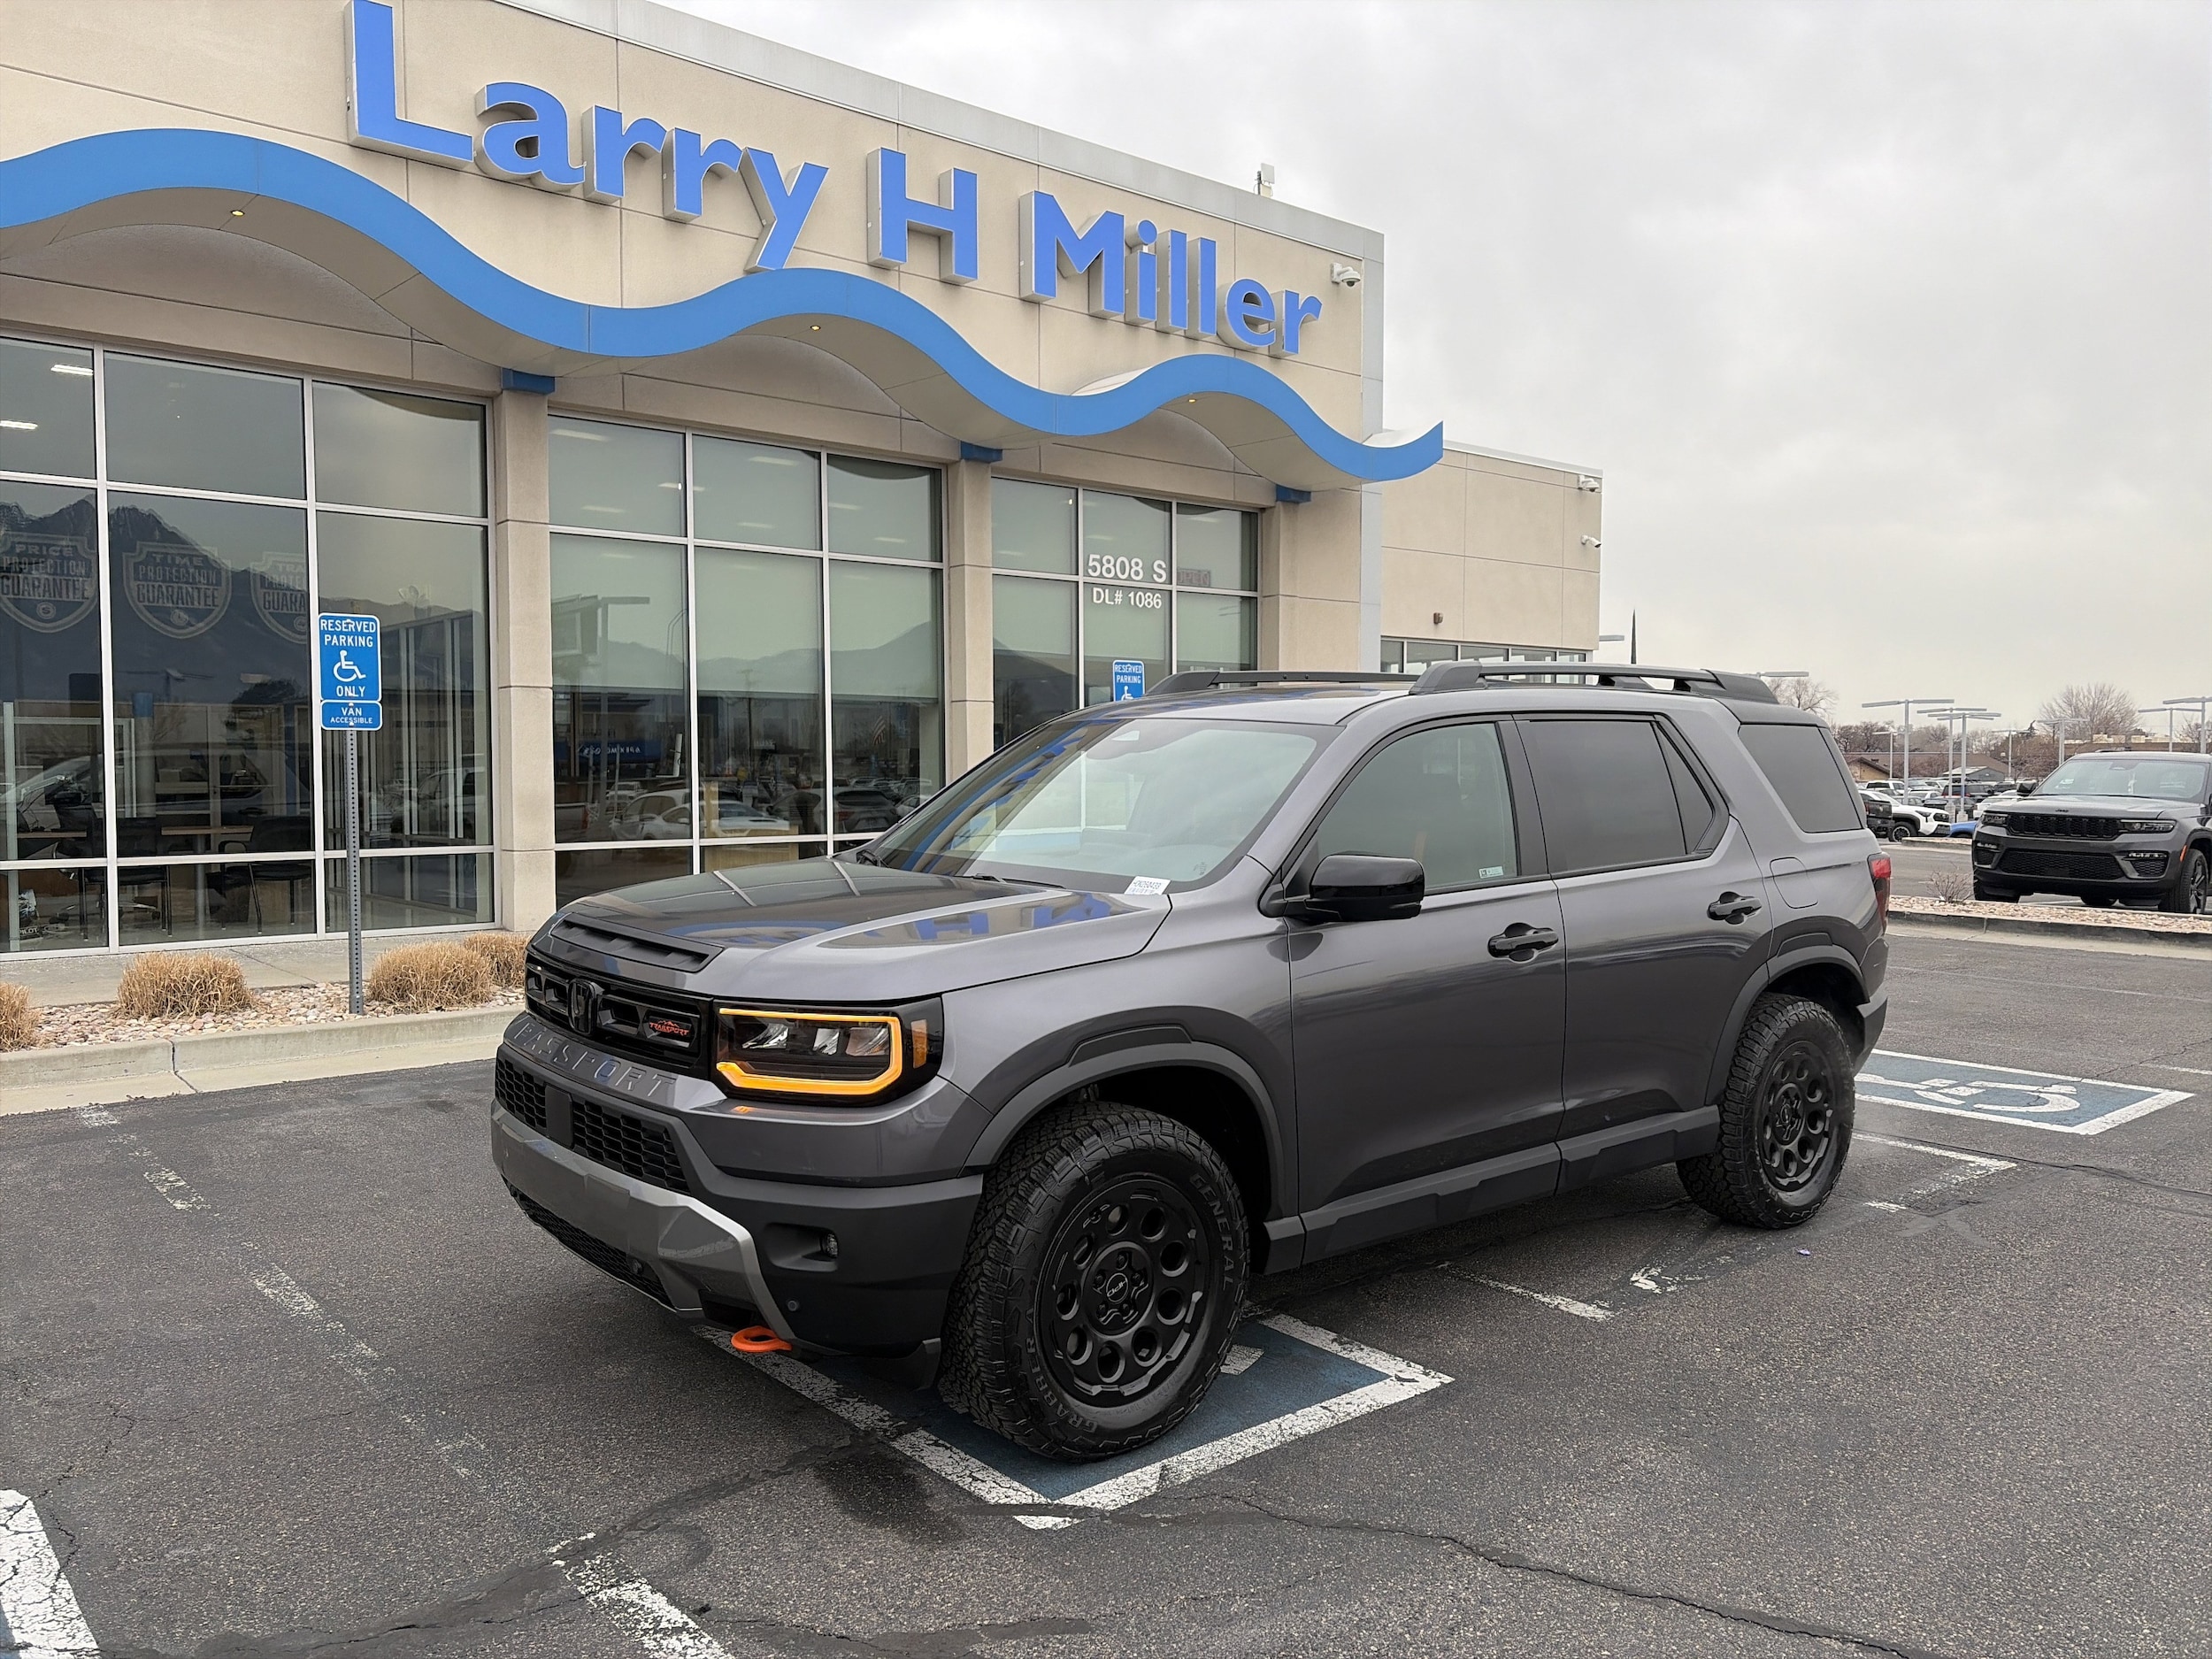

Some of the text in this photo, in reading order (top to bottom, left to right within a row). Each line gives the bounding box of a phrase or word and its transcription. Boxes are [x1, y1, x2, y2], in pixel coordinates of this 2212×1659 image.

[347, 0, 1323, 355] Larry H Miller
[15, 543, 73, 557] PRICE
[3, 556, 86, 576] PROTECTION
[151, 553, 204, 566] TIME
[139, 565, 217, 585] PROTECTION
[1087, 554, 1167, 583] 5808 S
[1, 574, 89, 601] GUARANTEE
[136, 584, 219, 608] GUARANTEE
[1093, 588, 1163, 609] DL# 1086
[320, 619, 377, 634] RESERVED
[324, 634, 373, 648] PARKING
[1115, 664, 1143, 674] RESERVED
[1117, 674, 1141, 684] PARKING
[336, 685, 365, 697] ONLY
[342, 707, 362, 717] VAN
[330, 716, 373, 725] ACCESSIBLE
[649, 1022, 690, 1036] TRAILSPORT
[1189, 1172, 1235, 1292] GENERAL
[1025, 1337, 1098, 1433] GRABBER
